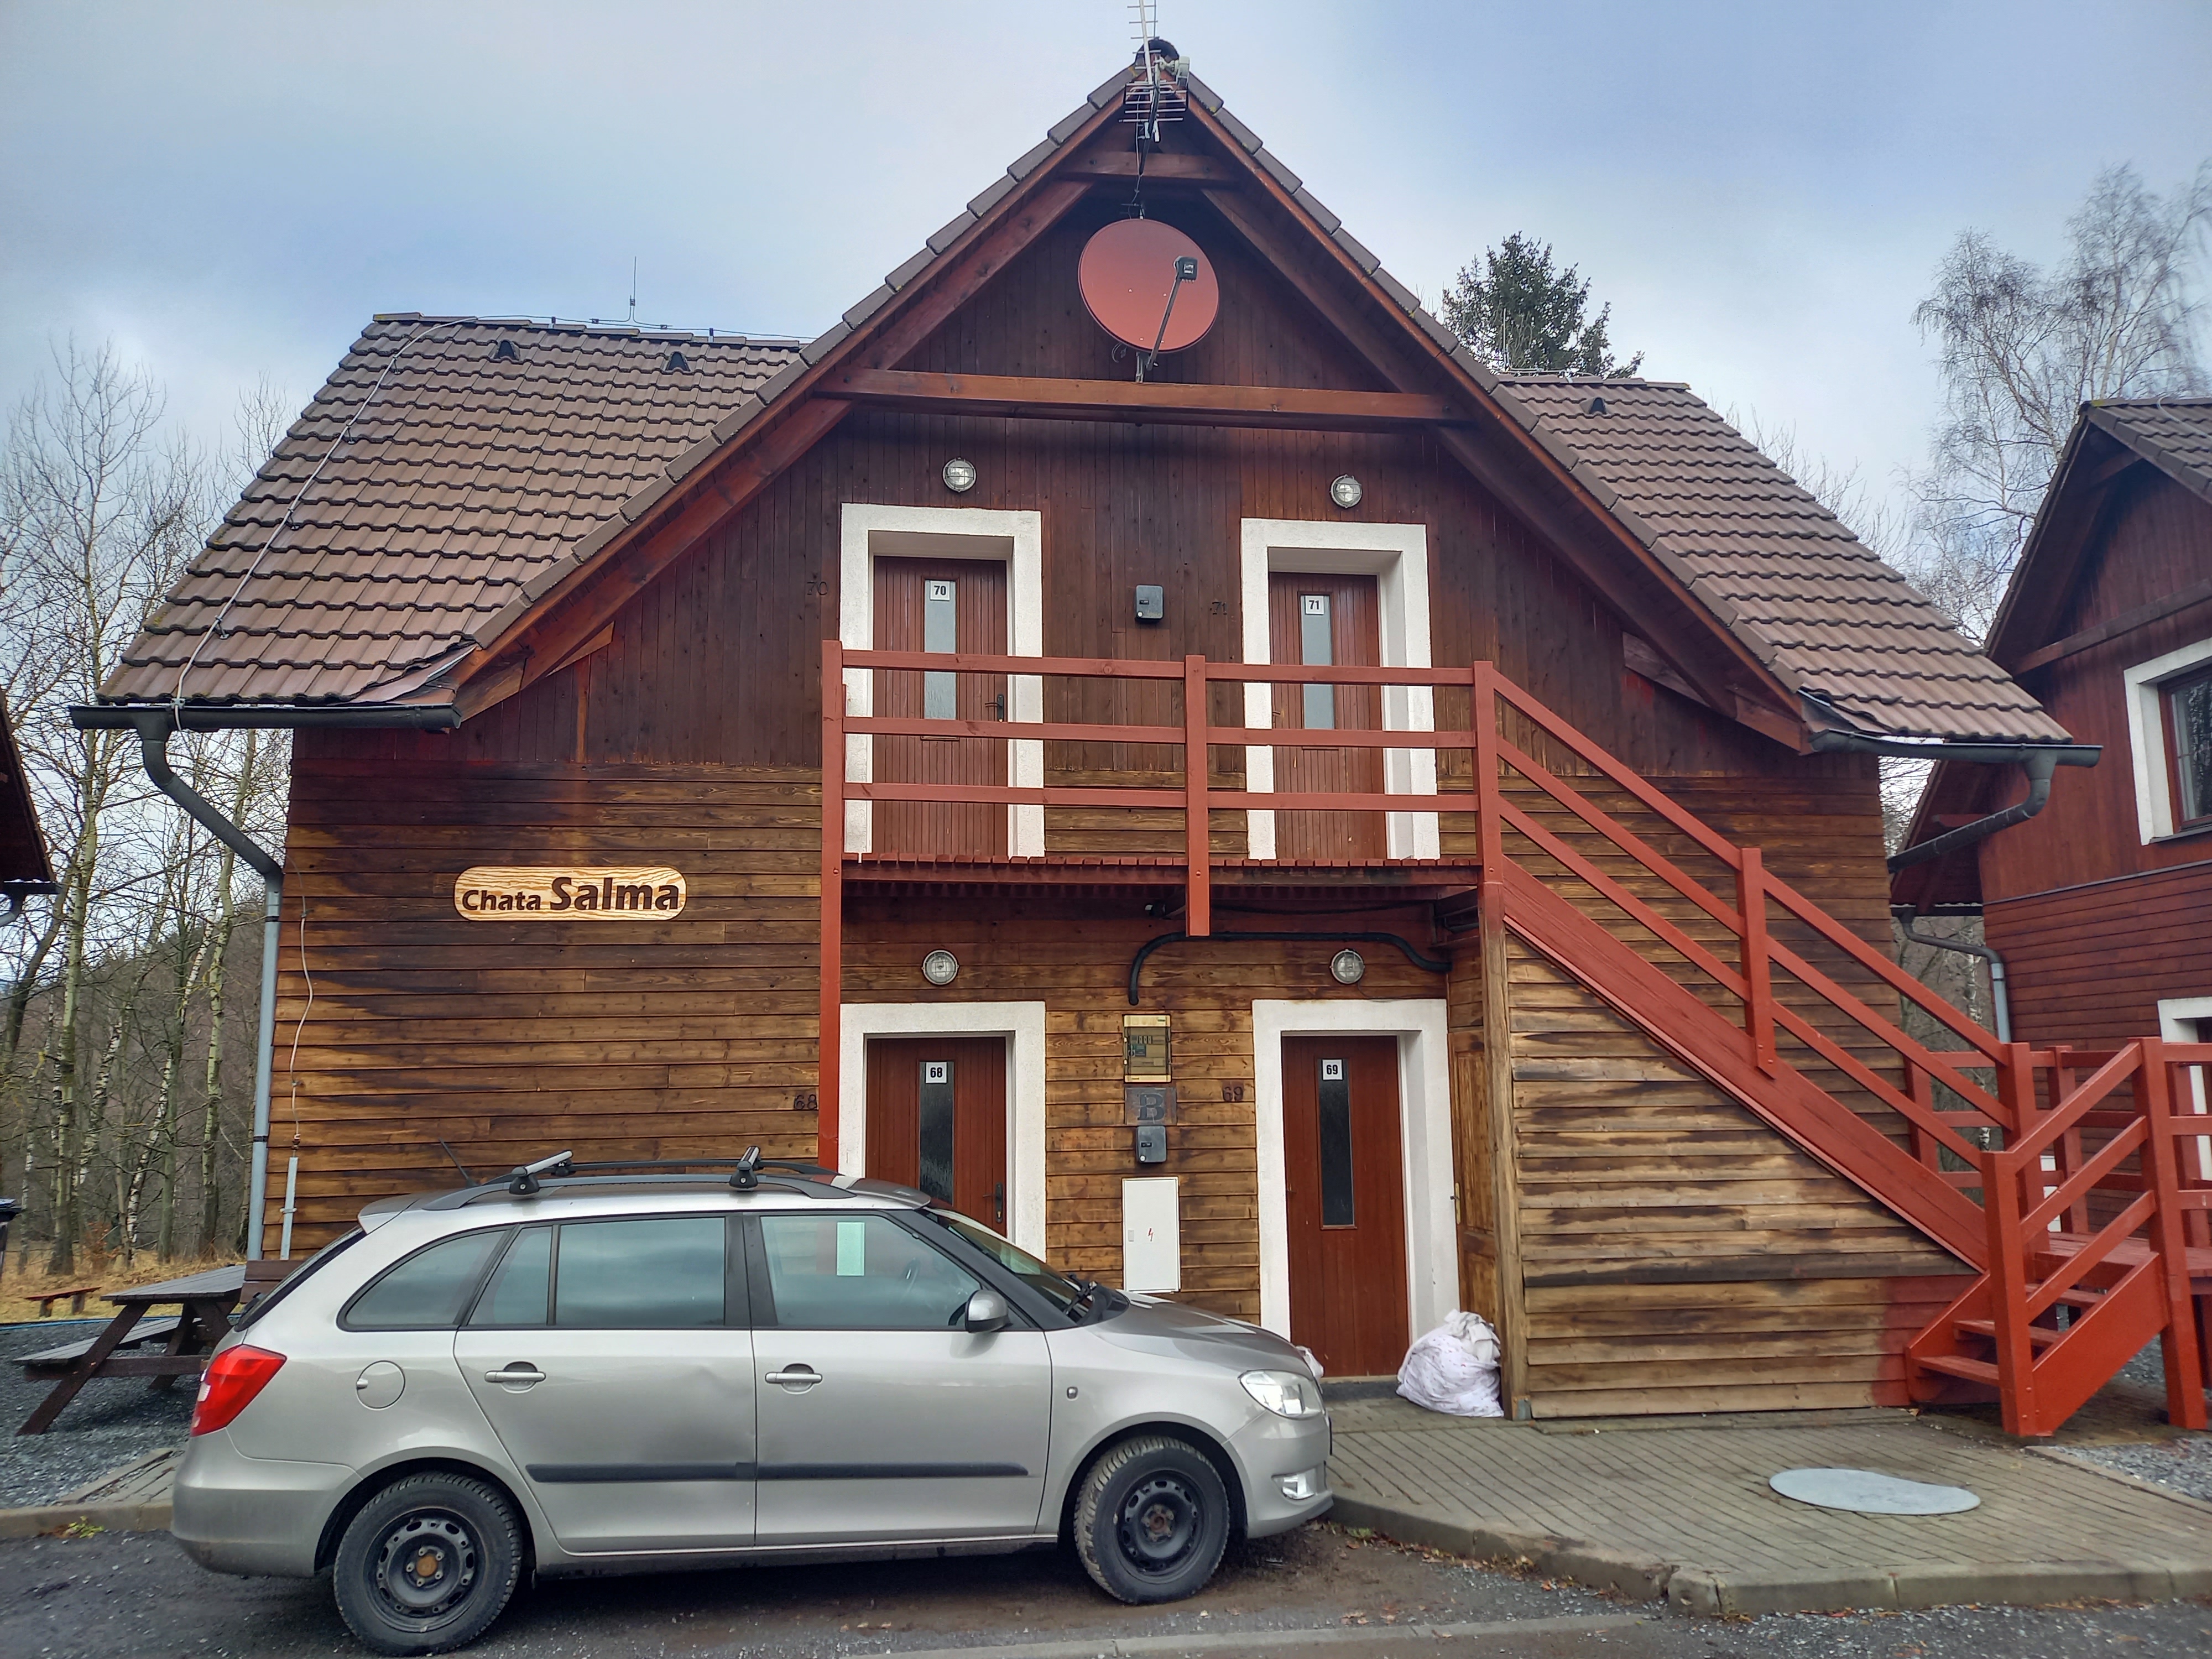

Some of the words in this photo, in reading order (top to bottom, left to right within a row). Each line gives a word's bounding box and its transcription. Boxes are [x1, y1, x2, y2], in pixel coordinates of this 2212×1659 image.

[807, 581, 828, 596] 70
[933, 585, 947, 596] 70
[1308, 599, 1320, 610] 71
[462, 890, 541, 910] Chata
[550, 877, 679, 910] Salma
[930, 1067, 943, 1078] 68
[1326, 1065, 1338, 1075] 69
[1223, 1086, 1244, 1102] 69
[794, 1094, 817, 1110] 68
[1138, 1093, 1165, 1120] B
